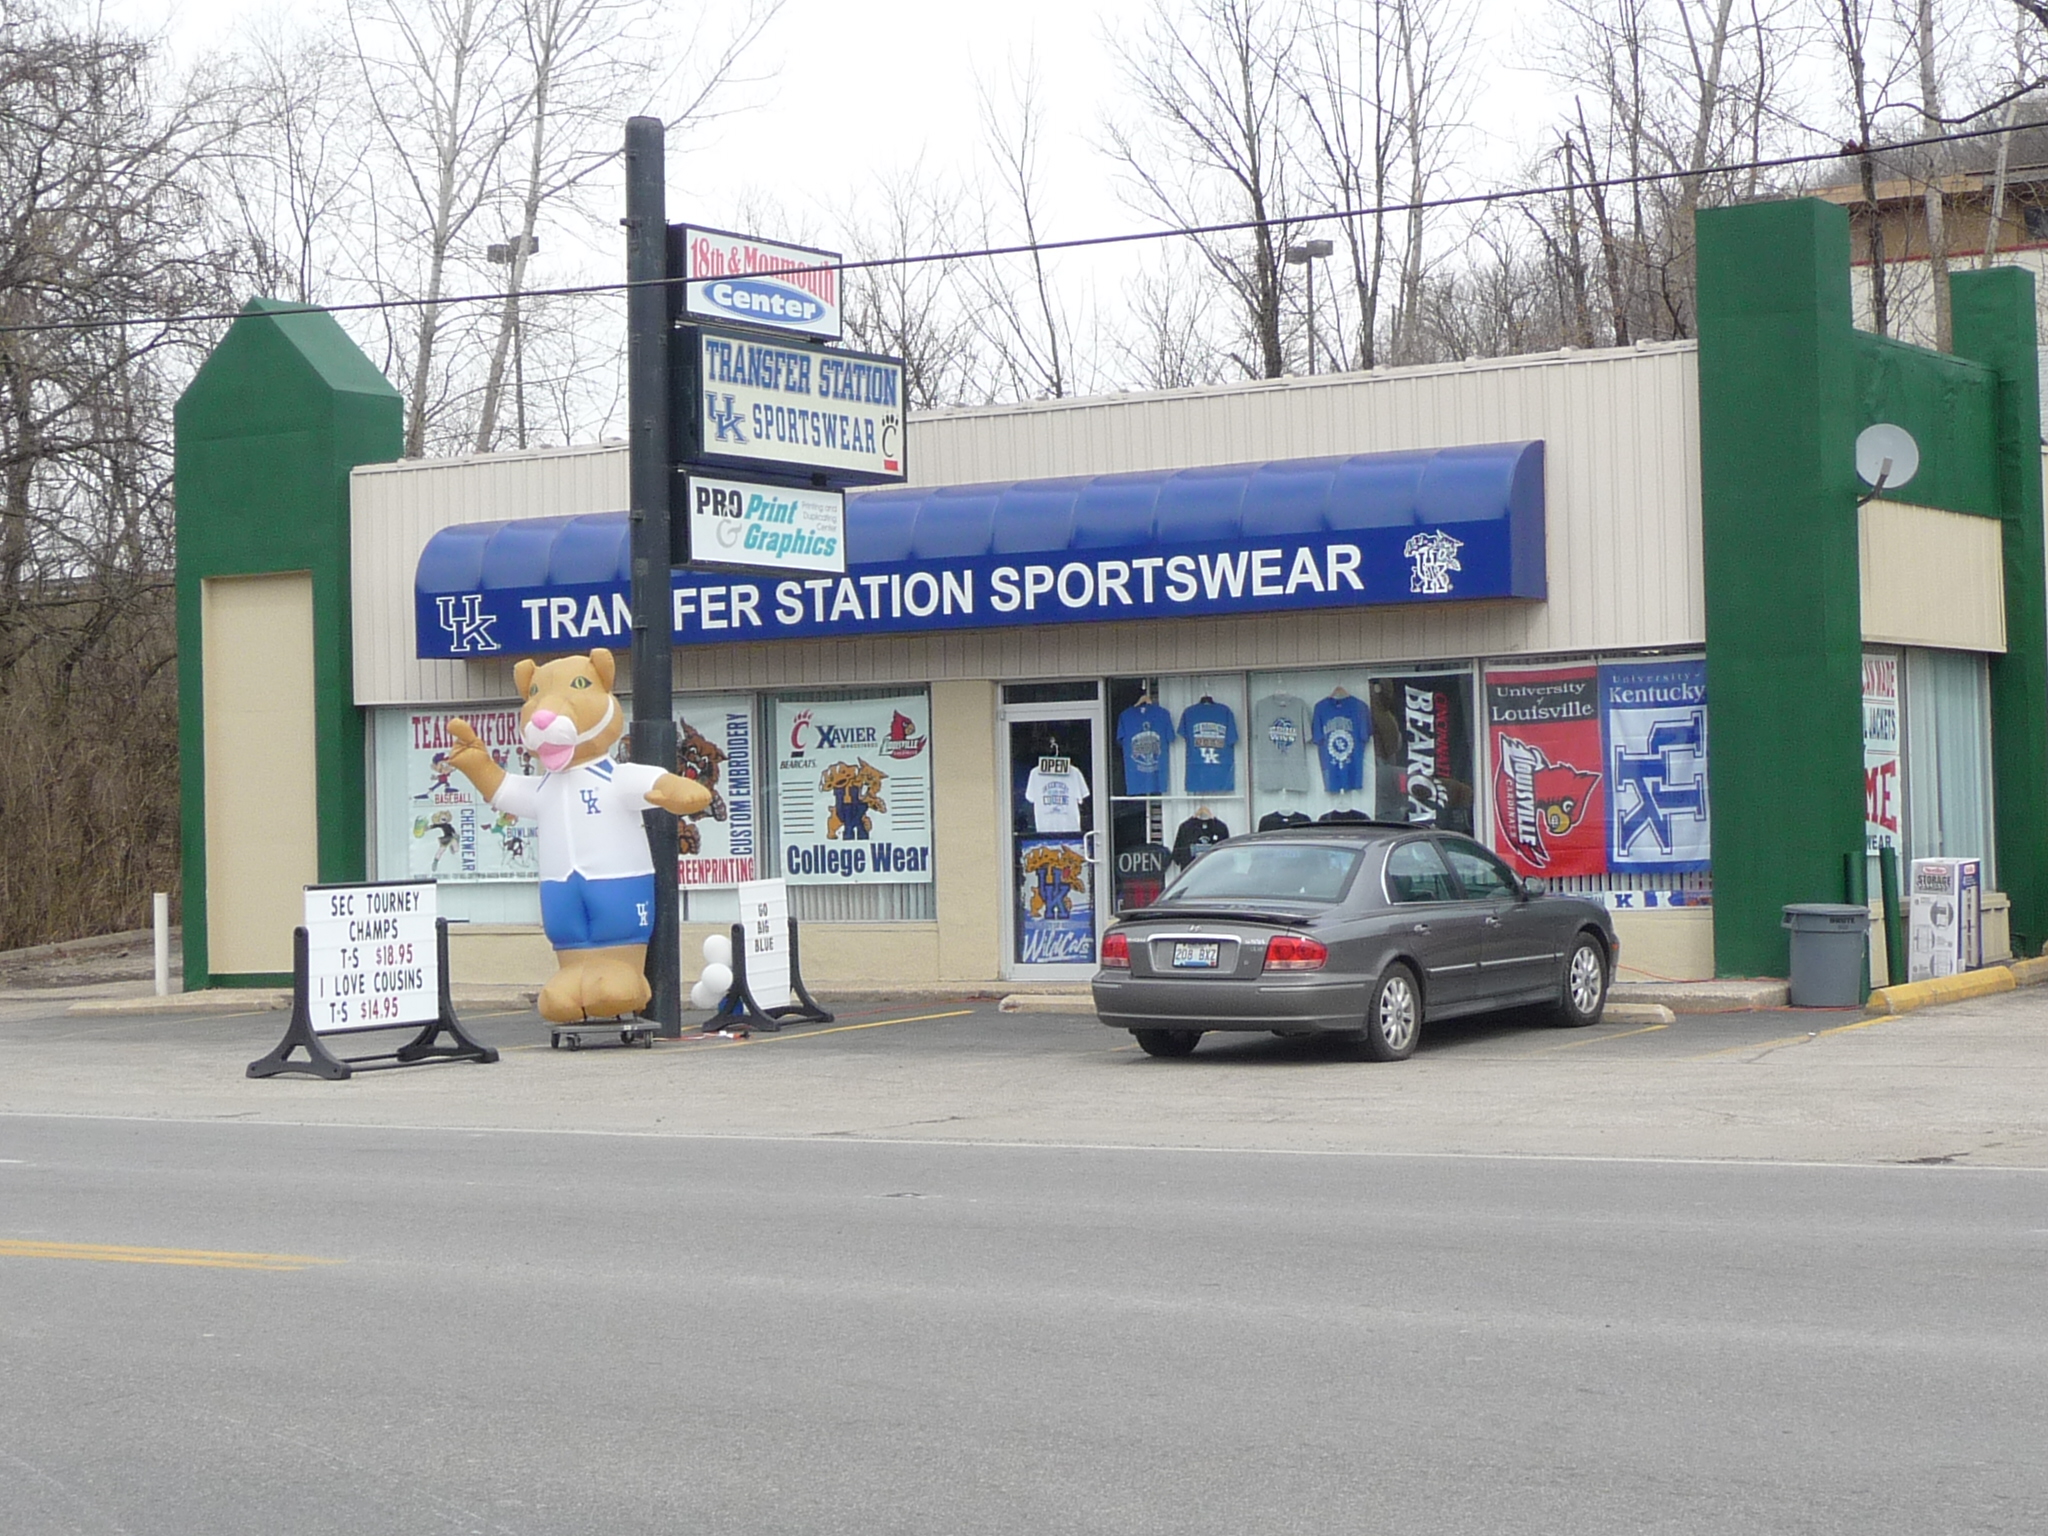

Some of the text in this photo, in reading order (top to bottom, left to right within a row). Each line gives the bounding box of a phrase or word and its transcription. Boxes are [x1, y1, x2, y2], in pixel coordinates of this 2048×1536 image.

[690, 237, 835, 307] 18th & Monmouth
[713, 284, 816, 320] Center
[705, 340, 897, 407] TRANSFER STATION
[705, 391, 748, 443] UK
[753, 403, 876, 454] SPORTSWEAR
[696, 486, 798, 524] PRO Print
[743, 524, 837, 559] Graphics
[521, 544, 1364, 640] TRANFER STATION SPORTSWEAR
[437, 595, 497, 651] UK
[1497, 681, 1586, 699] University
[1612, 671, 1691, 684] University
[1609, 683, 1706, 704] Kentucky
[1492, 701, 1594, 722] Louisville
[815, 724, 877, 749] XAVIER
[1041, 758, 1069, 773] OPEN
[1405, 684, 1437, 828] BEARCA
[727, 713, 752, 855] CUSTOM EMBROIDERY
[1615, 710, 1707, 857] UK
[435, 793, 473, 804] BASEBALL
[460, 808, 475, 871] CHEERWEAR
[678, 857, 754, 884] REENPRINTING
[787, 842, 929, 877] College Wear
[1119, 852, 1162, 873] OPEN
[331, 891, 420, 916] SEC TOURNEY
[757, 903, 768, 917] GO
[349, 918, 398, 942] CHAMPS
[375, 944, 413, 966] $18.95
[754, 937, 774, 952] BLUE
[335, 974, 365, 997] LOVE
[373, 968, 423, 993] COUSINS
[360, 997, 398, 1021] $14.95
